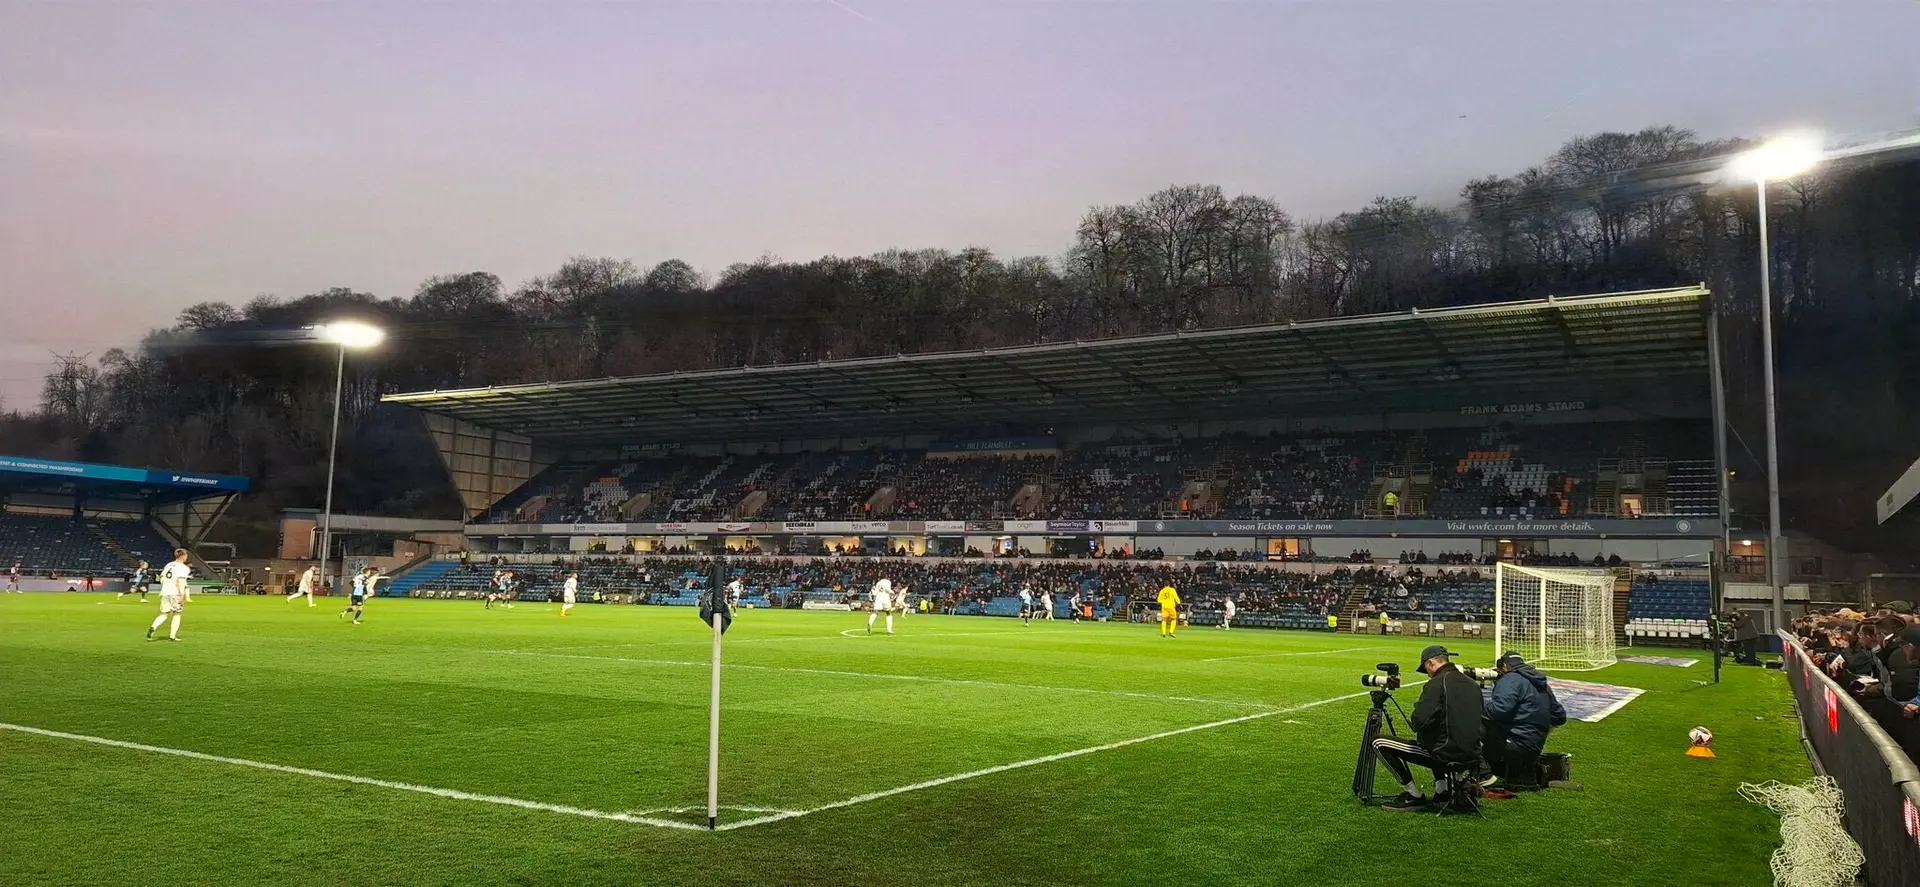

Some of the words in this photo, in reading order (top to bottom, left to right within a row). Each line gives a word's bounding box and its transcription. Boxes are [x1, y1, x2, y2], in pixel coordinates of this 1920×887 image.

[1460, 405, 1499, 415] FRANK
[1502, 403, 1542, 413] ADAMS
[1547, 401, 1585, 411] STAND
[1228, 522, 1256, 531] Season
[1257, 522, 1284, 531] Tickets
[1298, 522, 1314, 531] sale
[1447, 522, 1466, 531] Visit
[1468, 522, 1515, 531] wwfc.com
[1516, 522, 1531, 531] for
[1560, 522, 1595, 531] details.
[165, 567, 173, 579] 6
